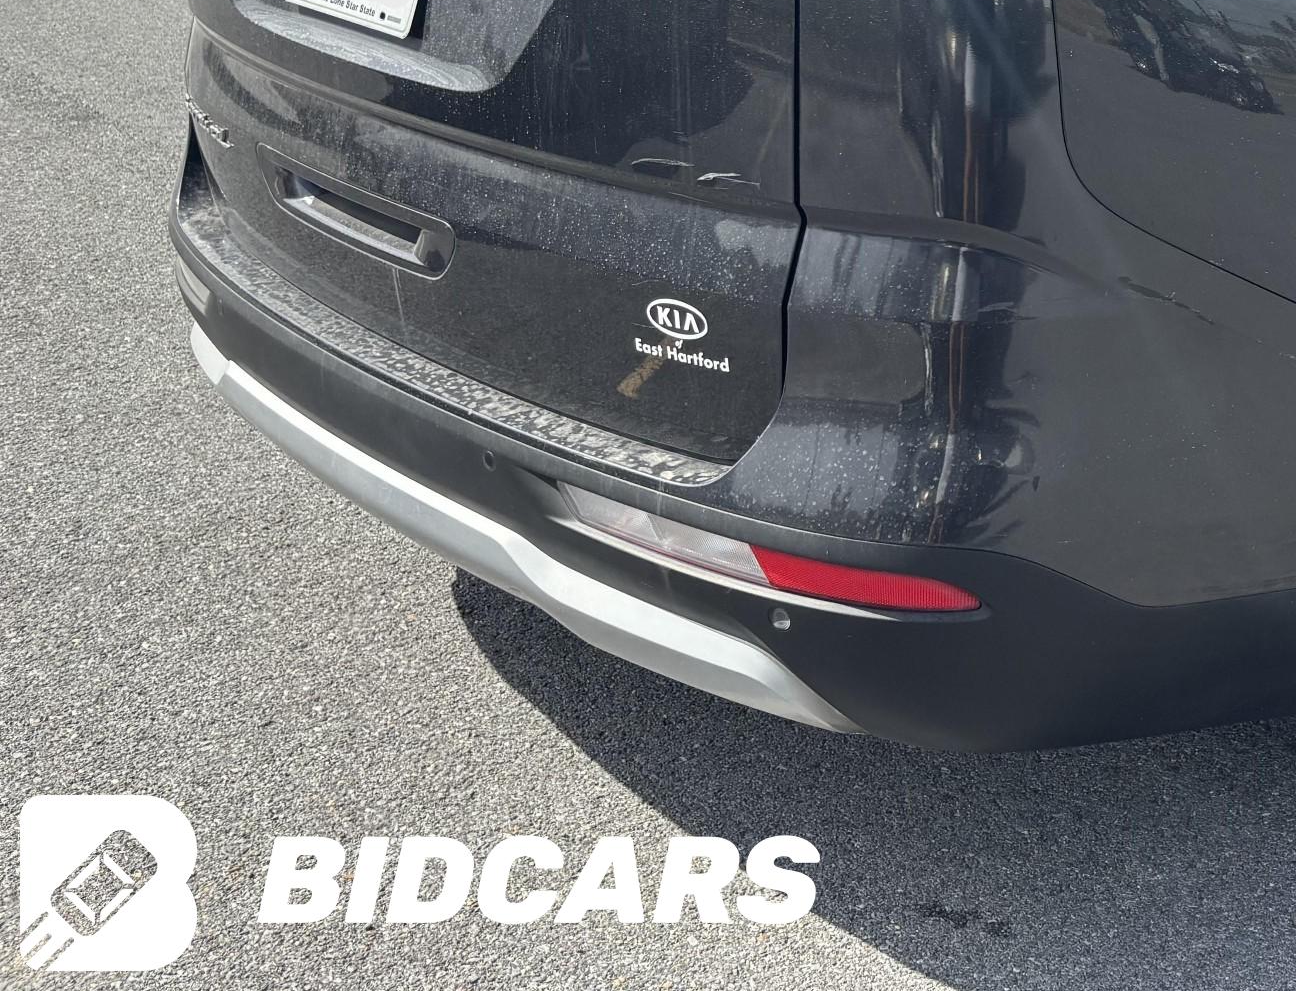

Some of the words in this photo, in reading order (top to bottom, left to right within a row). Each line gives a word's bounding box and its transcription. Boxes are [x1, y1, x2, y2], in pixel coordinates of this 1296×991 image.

[345, 0, 359, 11] Star
[359, 4, 376, 17] State
[656, 305, 700, 334] KIA
[634, 337, 662, 357] East
[666, 345, 730, 373] Hartford
[674, 339, 683, 349] of
